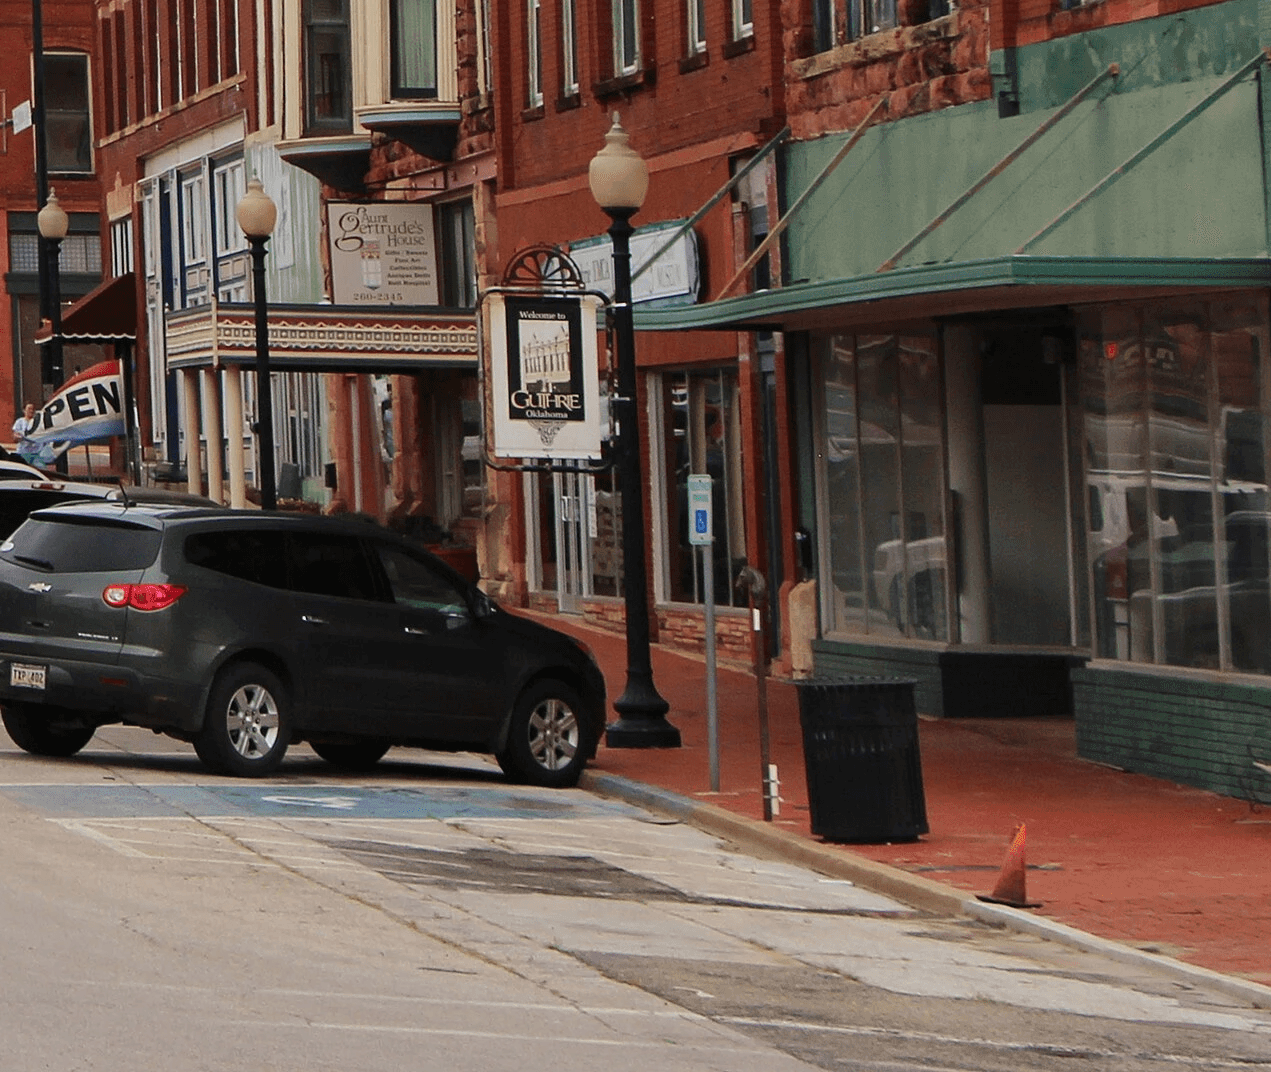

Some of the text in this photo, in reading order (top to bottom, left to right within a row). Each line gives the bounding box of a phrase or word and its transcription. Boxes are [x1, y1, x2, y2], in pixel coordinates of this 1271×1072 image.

[519, 311, 556, 320] Welcome
[511, 390, 582, 411] GUTHRIE
[525, 410, 568, 418] Oklahoma
